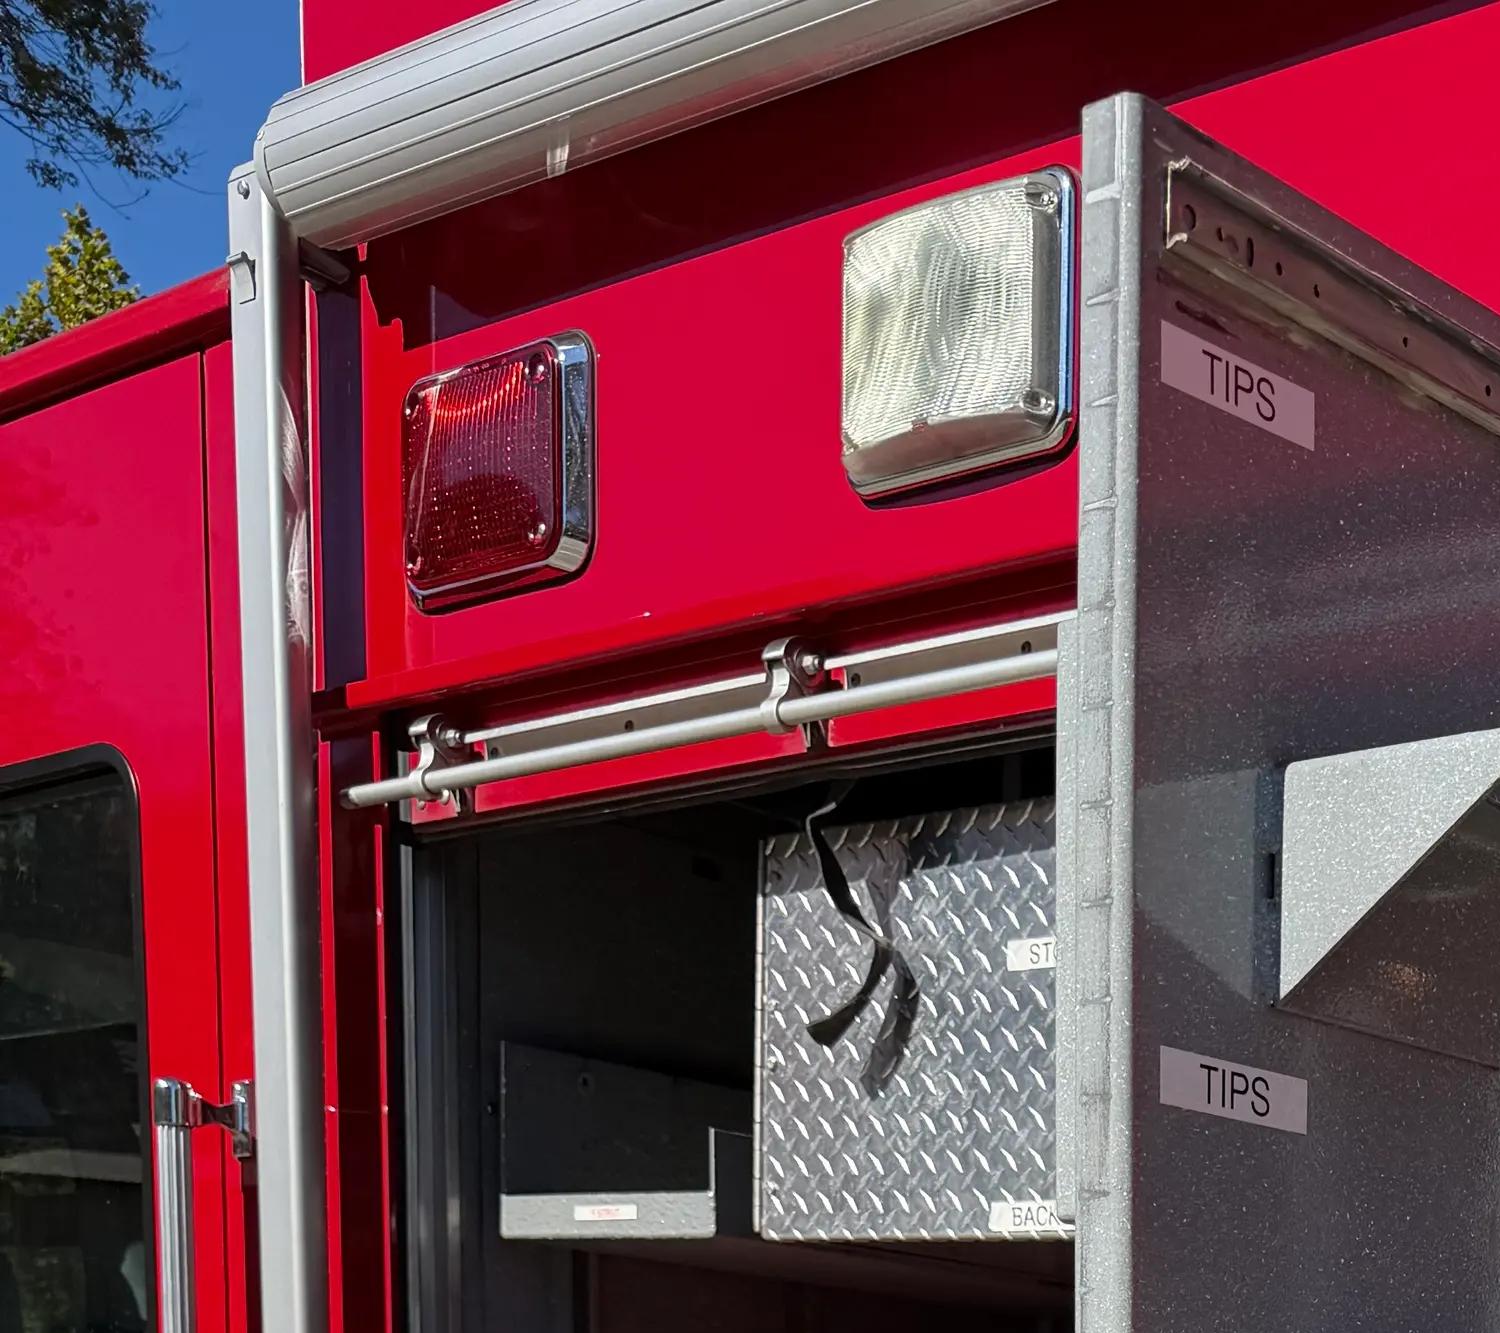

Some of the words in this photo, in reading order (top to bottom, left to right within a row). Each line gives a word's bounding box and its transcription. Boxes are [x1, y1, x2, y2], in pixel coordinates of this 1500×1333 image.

[1201, 348, 1276, 422] TIPS
[1029, 941, 1057, 965] ST
[1199, 1062, 1271, 1118] TIPS
